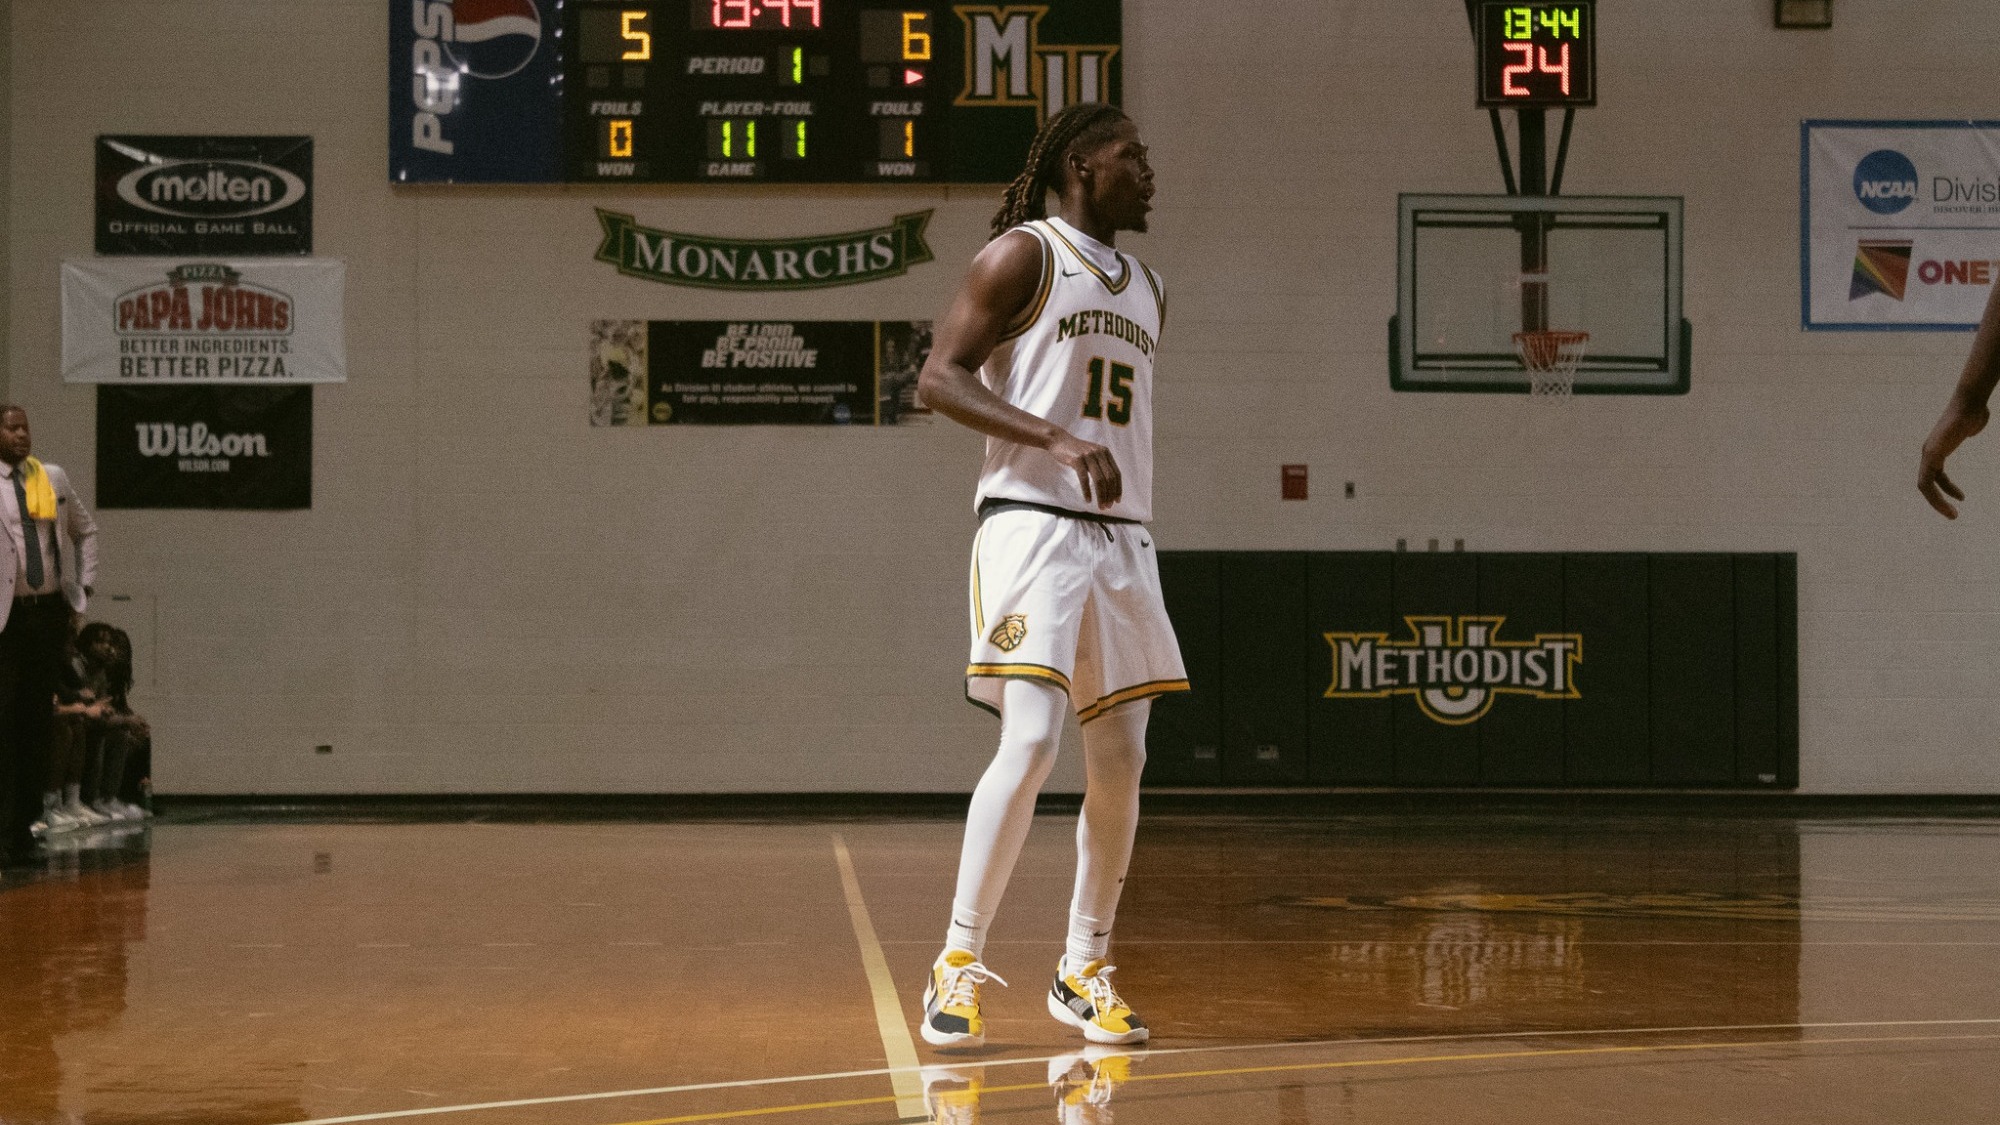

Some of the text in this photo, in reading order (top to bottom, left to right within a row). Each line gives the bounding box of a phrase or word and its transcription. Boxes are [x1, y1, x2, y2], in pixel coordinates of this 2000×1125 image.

[621, 11, 651, 60] 5
[902, 12, 931, 60] 6
[1504, 7, 1579, 39] 13:44
[412, 0, 455, 155] PEPS
[688, 47, 802, 83] PERIOD 1
[1502, 42, 1570, 96] 24
[590, 102, 642, 116] FOULS
[701, 102, 813, 116] PLAYER-FOUL
[871, 102, 923, 116] FOULS
[609, 120, 632, 157] 0
[722, 120, 755, 157] 11
[796, 121, 806, 157] 1
[904, 120, 914, 157] 1
[152, 171, 271, 201] molten
[597, 162, 634, 176] WON
[707, 162, 755, 176] GAME
[878, 162, 915, 176] WON
[1860, 181, 1917, 199] NCAA
[109, 221, 297, 234] OFFICIAL GAME BALL
[632, 232, 895, 281] MONARCHS
[1918, 260, 1990, 285] ONE
[119, 286, 288, 331] PAPA JOHNS
[120, 339, 179, 354] BETTER
[701, 350, 818, 368] BE POSITIVE
[120, 356, 293, 378] BETTER PIZZA.
[1081, 356, 1135, 428] 15
[135, 421, 269, 457] Wilson
[1339, 641, 1575, 691] METHODIST
